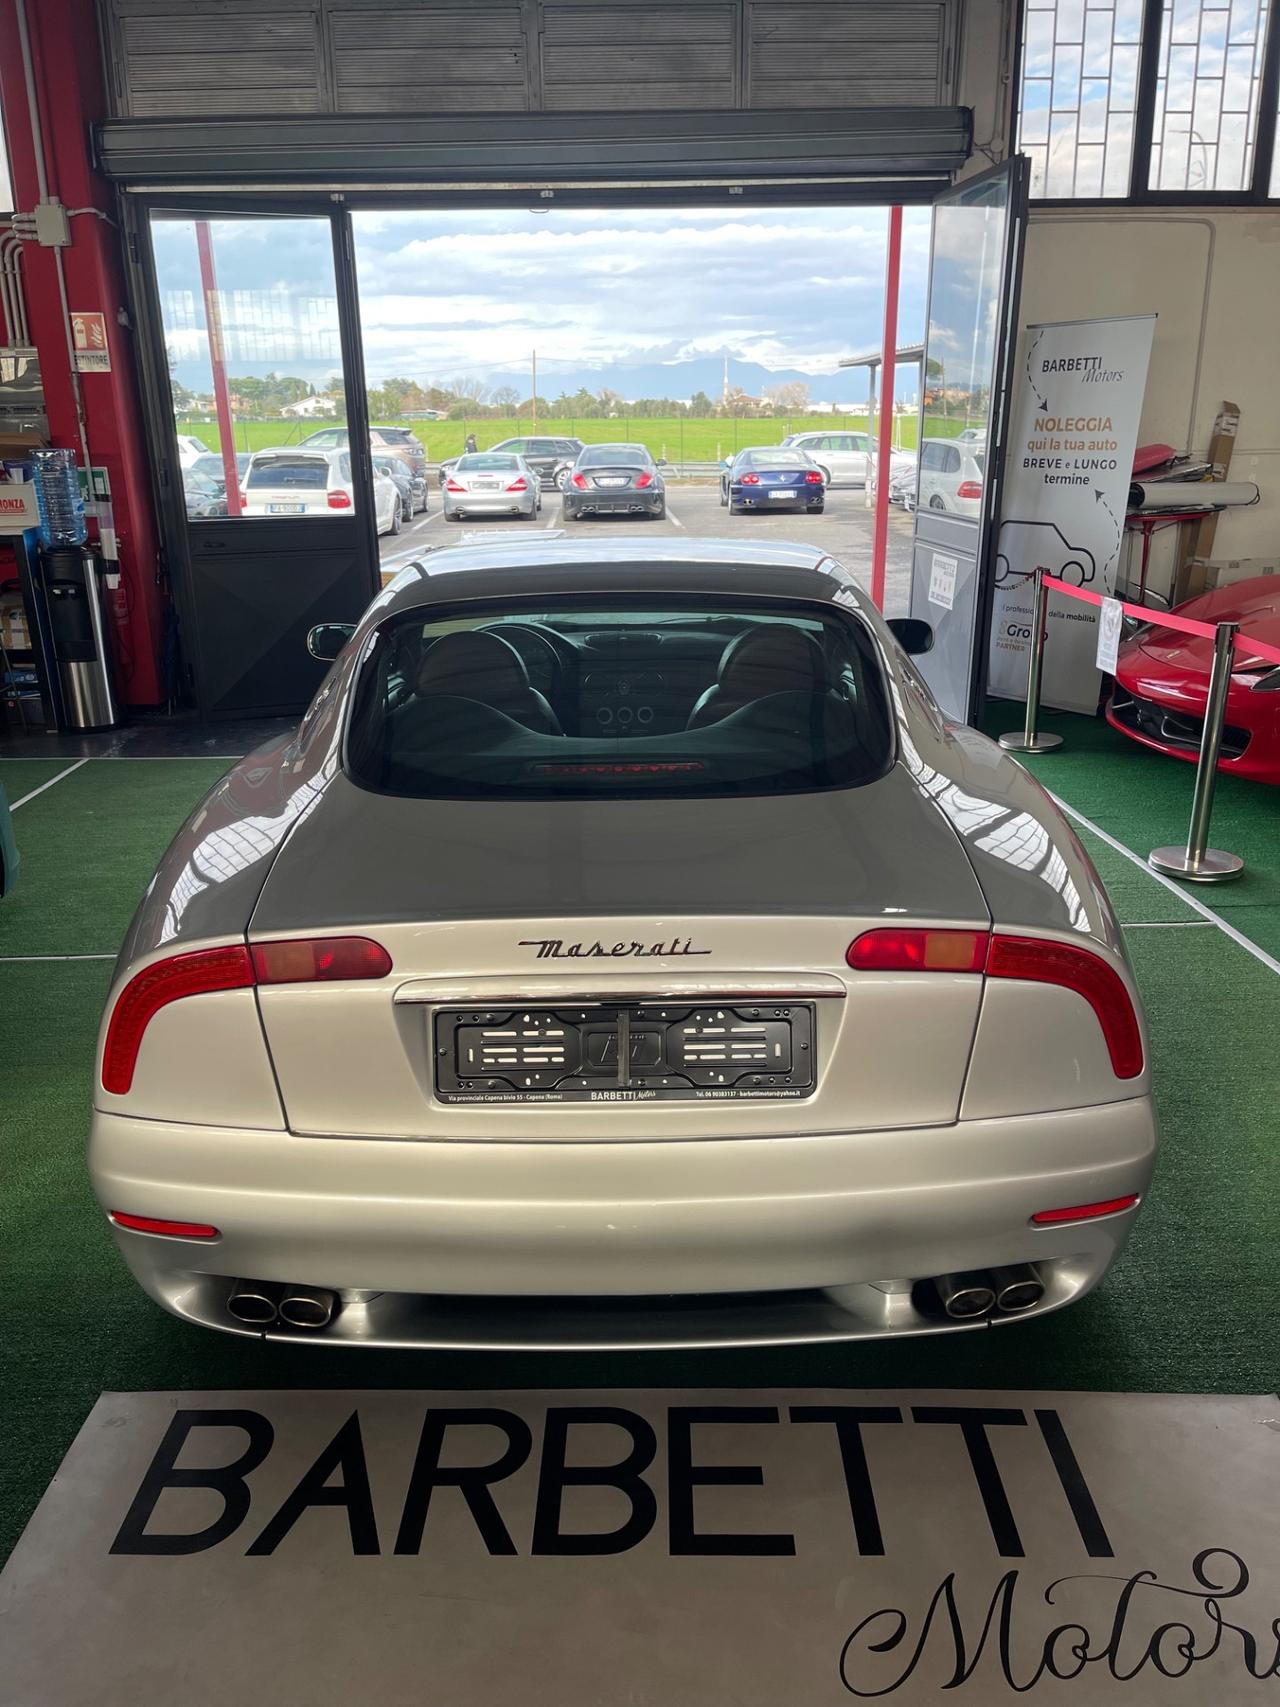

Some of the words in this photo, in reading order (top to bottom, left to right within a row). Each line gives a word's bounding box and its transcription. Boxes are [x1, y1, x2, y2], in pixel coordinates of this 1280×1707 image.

[1042, 357, 1102, 372] BARBETTI
[1082, 368, 1124, 383] Motors
[1034, 417, 1112, 432] NOLEGGIA
[1027, 437, 1047, 453] qui
[1049, 438, 1060, 450] la
[1064, 439, 1085, 450] tua
[1088, 439, 1118, 451] auto
[1023, 458, 1062, 469] BREVE
[1074, 459, 1117, 470] LUNGO
[1044, 473, 1090, 485] termine
[1048, 610, 1065, 619] della
[1066, 613, 1096, 623] mobilità
[518, 937, 712, 959] Maserati
[485, 1094, 502, 1102] Capena
[591, 1091, 636, 1100] BARBETTI
[108, 1406, 1116, 1558] BARBETTI
